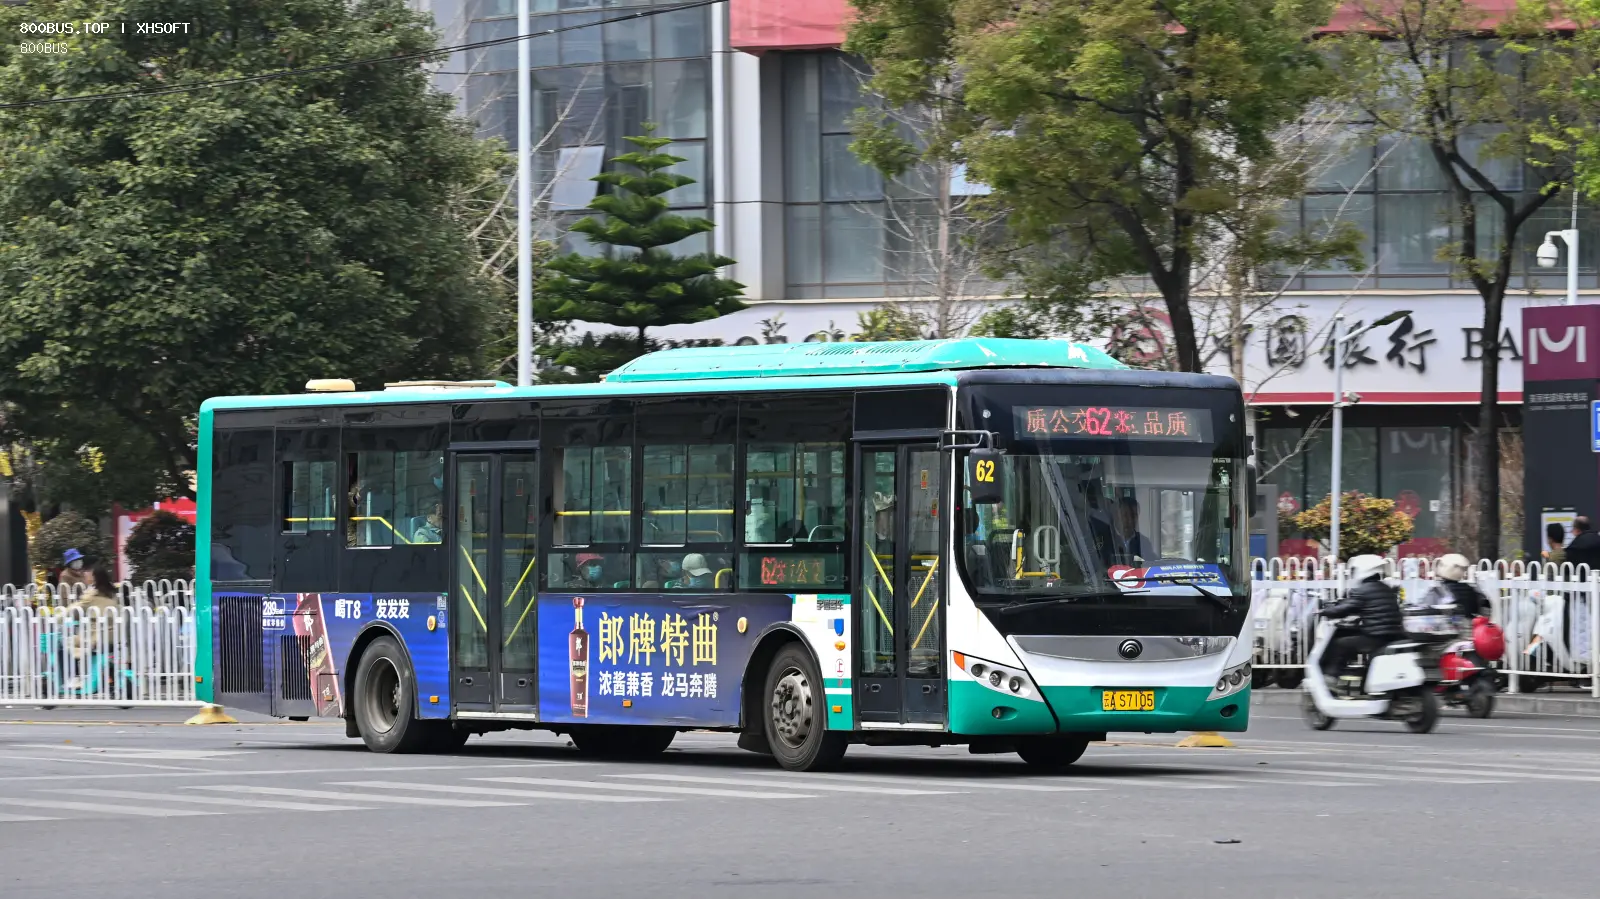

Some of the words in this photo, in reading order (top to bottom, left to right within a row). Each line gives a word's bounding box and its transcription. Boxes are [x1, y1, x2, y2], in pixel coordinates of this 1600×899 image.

[1086, 407, 1112, 435] 62
[975, 460, 994, 482] 62
[376, 598, 409, 619] 发发发
[599, 611, 718, 666] 郎牌特曲
[661, 672, 717, 698] 龙马奔腾
